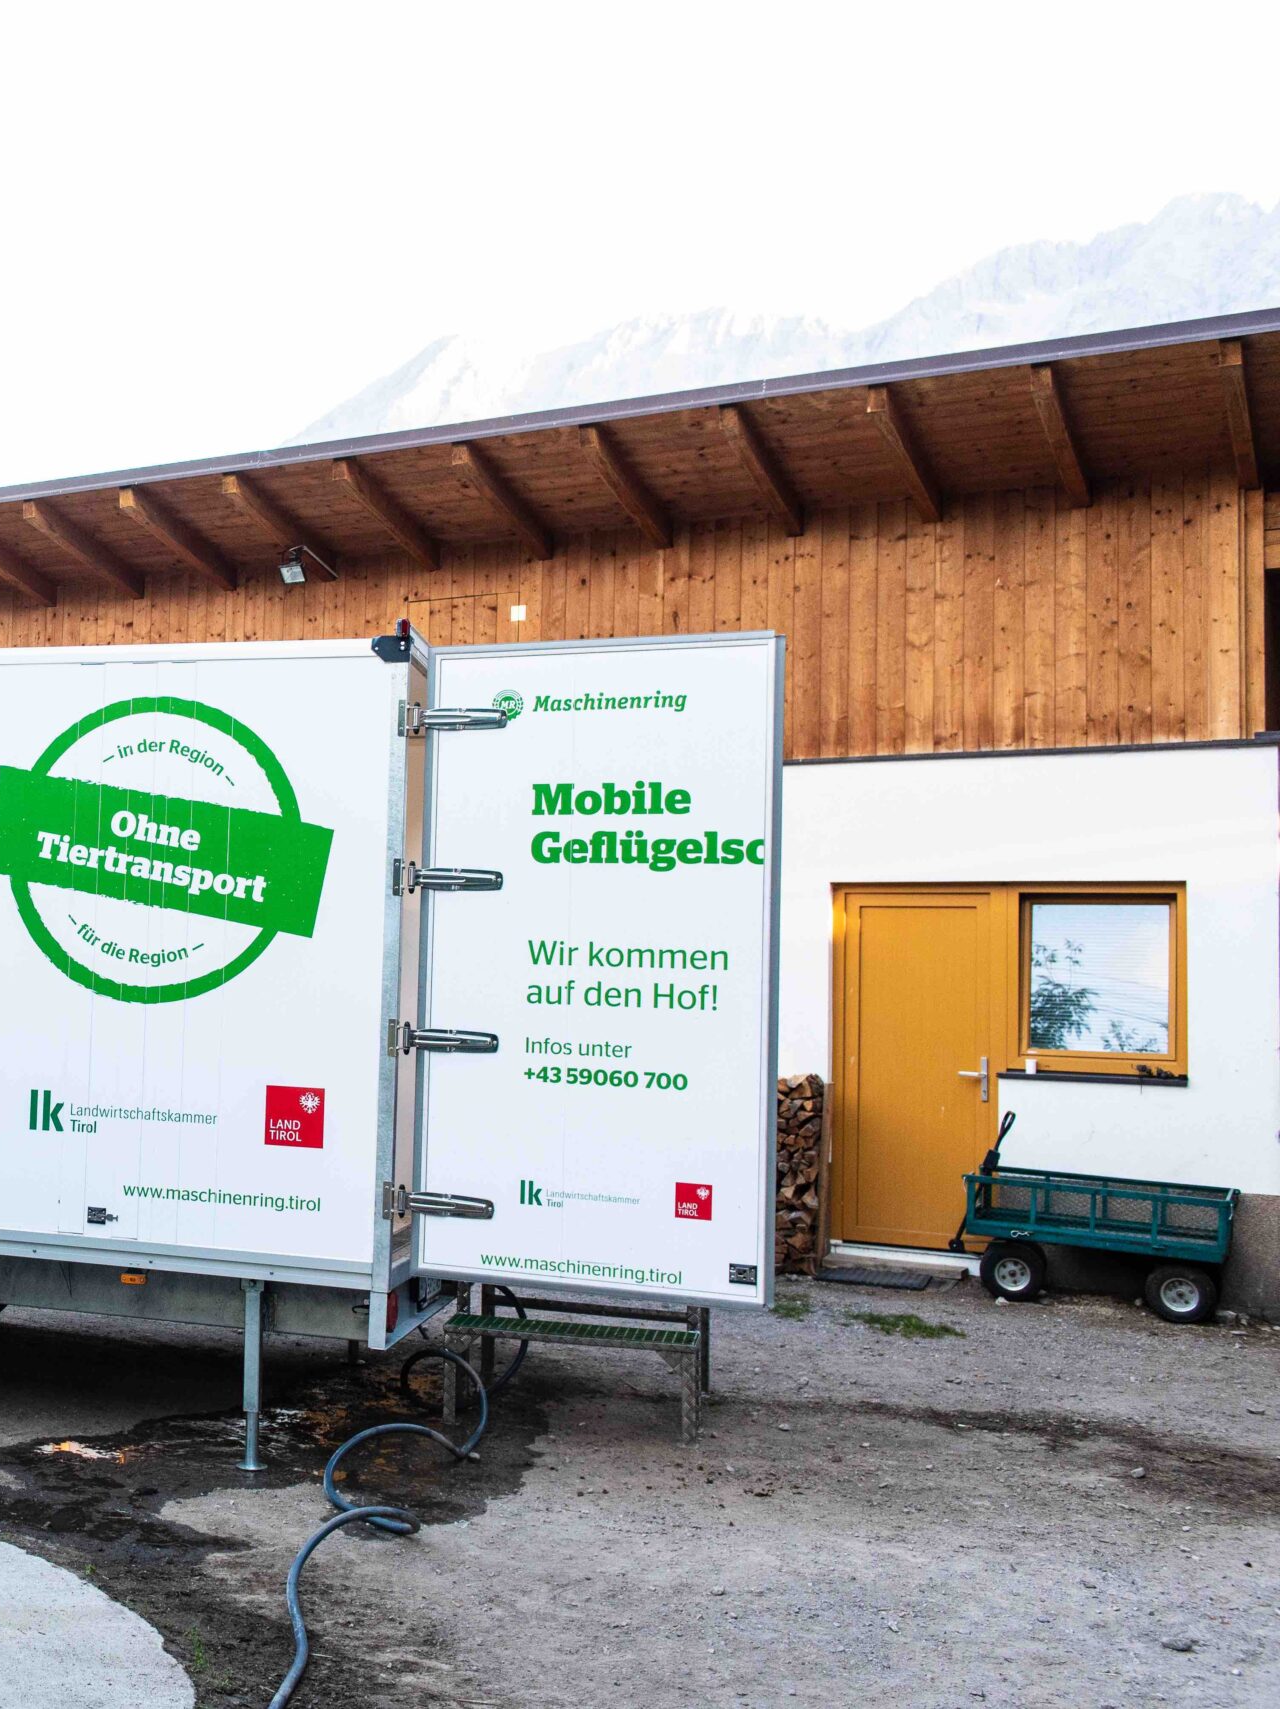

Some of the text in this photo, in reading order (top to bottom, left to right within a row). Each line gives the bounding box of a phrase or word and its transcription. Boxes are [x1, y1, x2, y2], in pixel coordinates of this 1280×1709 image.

[499, 699, 517, 710] MR
[534, 689, 688, 713] Maschinenring
[118, 738, 224, 776] in der Region
[532, 779, 693, 816] Mobile
[111, 810, 201, 851] Ohne
[37, 831, 267, 903] Tiertransport
[77, 923, 189, 968] für die Region
[528, 939, 729, 971] Wir kommen
[527, 979, 718, 1012] auf den Hof!
[525, 1036, 633, 1059] Infos unter
[524, 1066, 688, 1092] +43 59060 700
[29, 1088, 64, 1133] lk
[69, 1103, 218, 1125] Landwirtschaftskammer
[70, 1119, 98, 1136] Tirol
[270, 1118, 301, 1131] LAND
[270, 1129, 302, 1142] TIROL
[123, 1186, 321, 1212] www.maschinenring.tirol
[520, 1180, 542, 1207] lk
[545, 1188, 641, 1205] Landwirtschaftskammer
[546, 1199, 565, 1209] Tirol
[677, 1201, 698, 1210] LAND
[677, 1208, 699, 1217] TIROL
[480, 1255, 684, 1285] www.maschinenring.tirol
